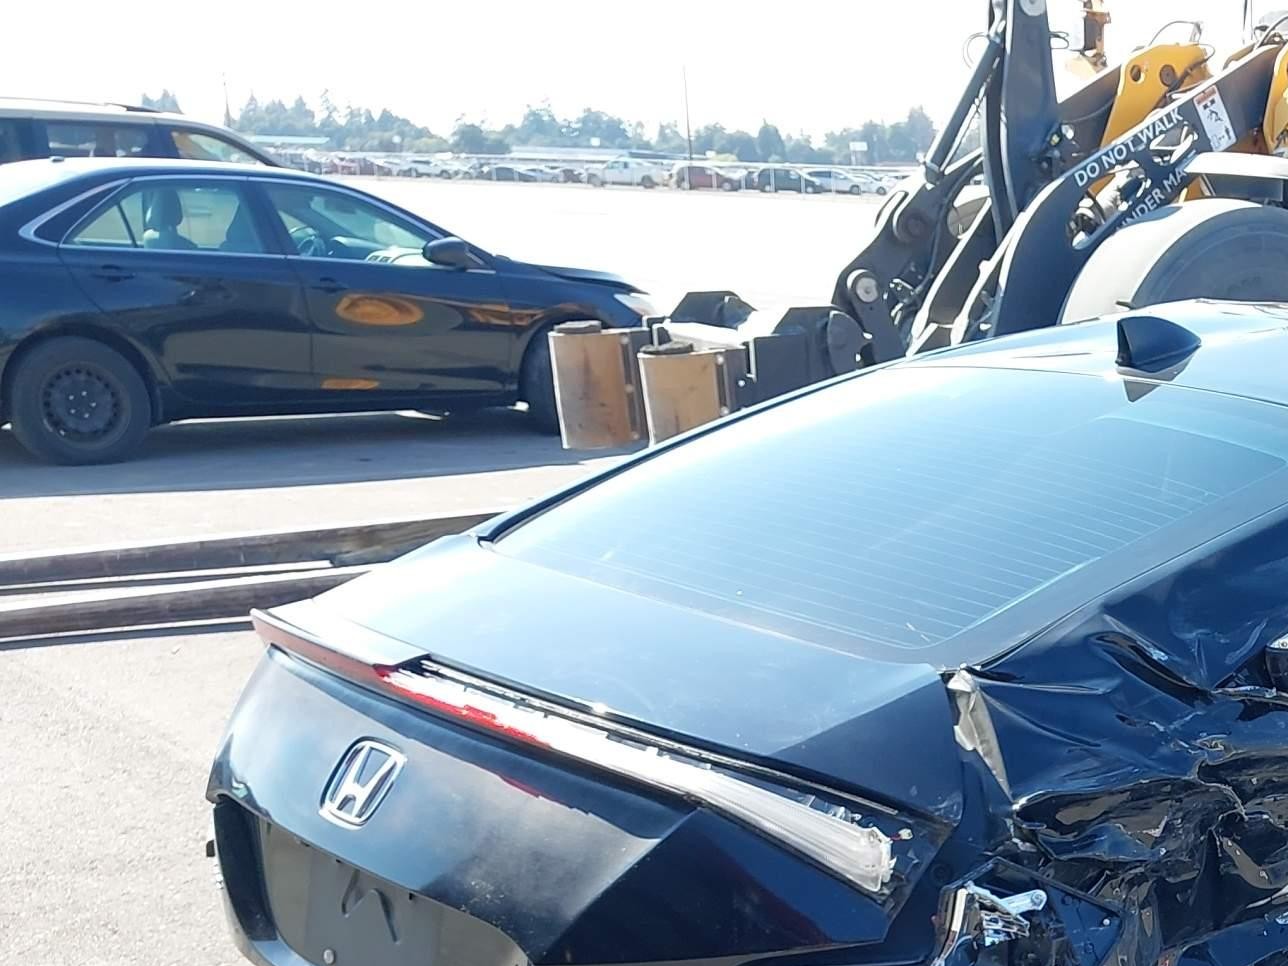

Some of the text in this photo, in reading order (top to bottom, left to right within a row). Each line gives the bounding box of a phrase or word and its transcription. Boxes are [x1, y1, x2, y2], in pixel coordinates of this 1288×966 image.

[1074, 107, 1184, 188] DO NOT WALK
[1116, 187, 1166, 231] NDER
